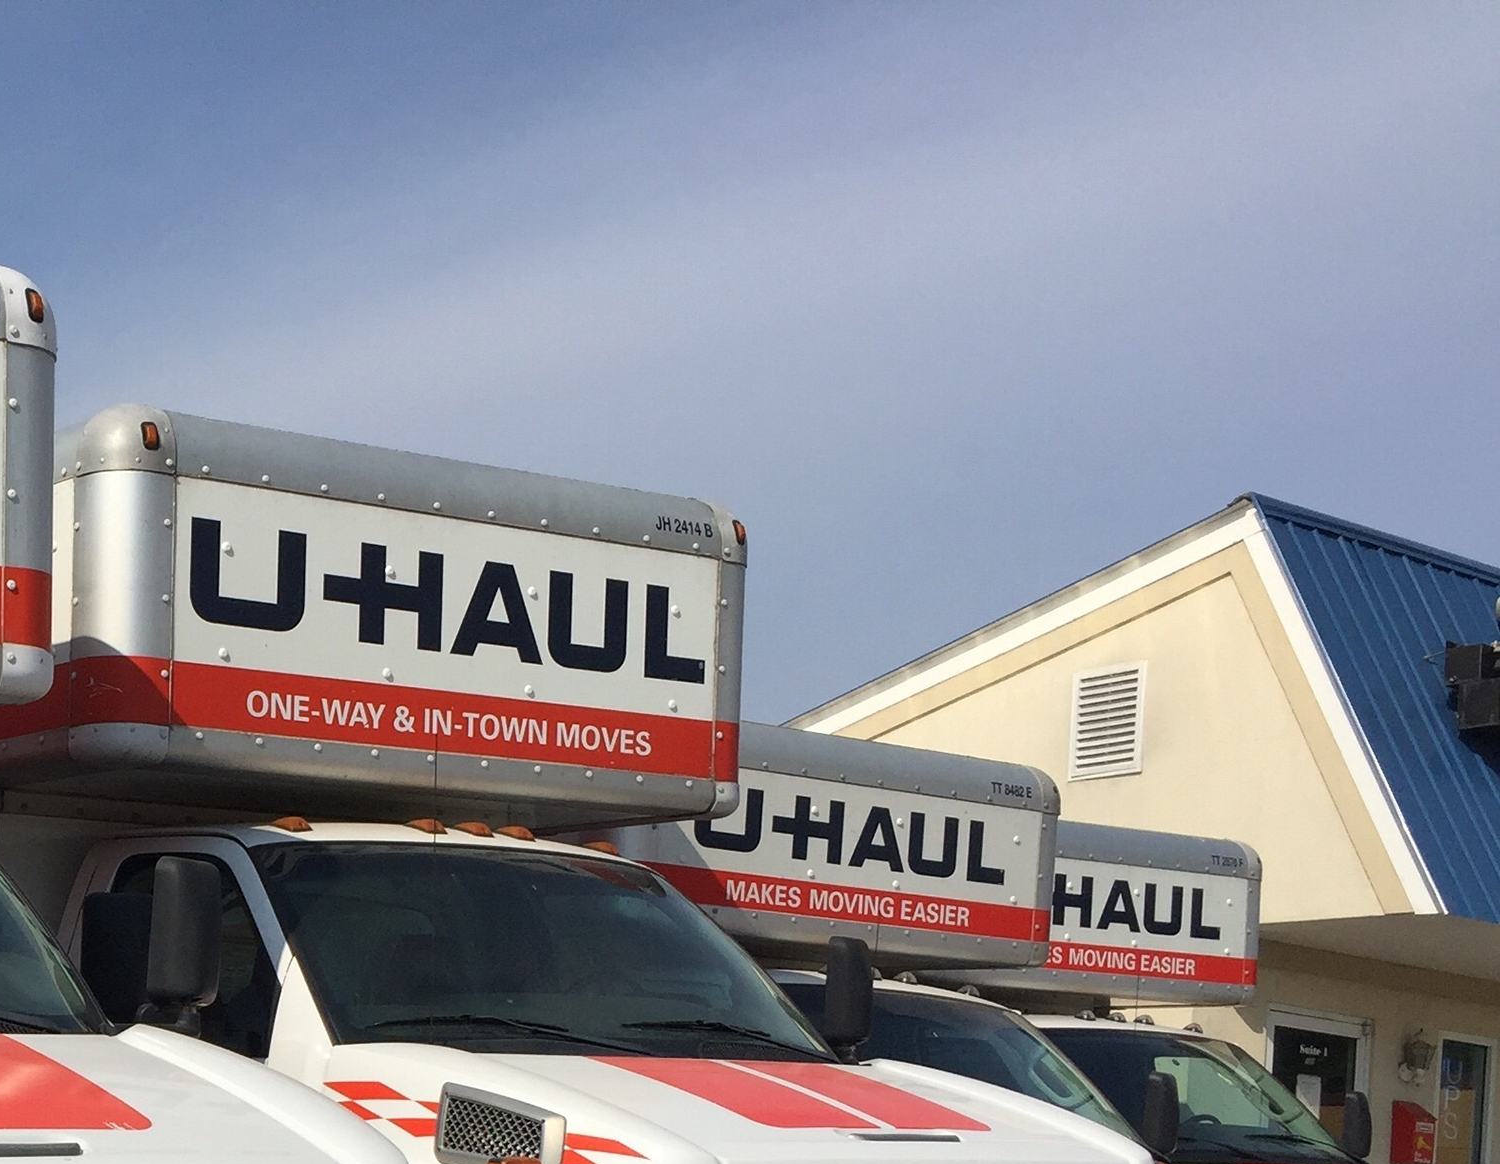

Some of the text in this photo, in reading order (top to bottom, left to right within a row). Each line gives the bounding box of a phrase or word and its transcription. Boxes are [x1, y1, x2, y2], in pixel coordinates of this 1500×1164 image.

[656, 515, 713, 538] JH 2414 B
[190, 516, 706, 684] U-HAUL
[246, 690, 652, 756] ONE-WAY & IN-TOWN MOVES
[991, 781, 1003, 794] TT
[694, 788, 1005, 886] U-HAUL
[726, 879, 970, 927] MAKES MOVING EASIER
[1068, 948, 1137, 971] MOVING
[1140, 955, 1196, 976] EASIER
[1443, 1057, 1463, 1140] UPS
